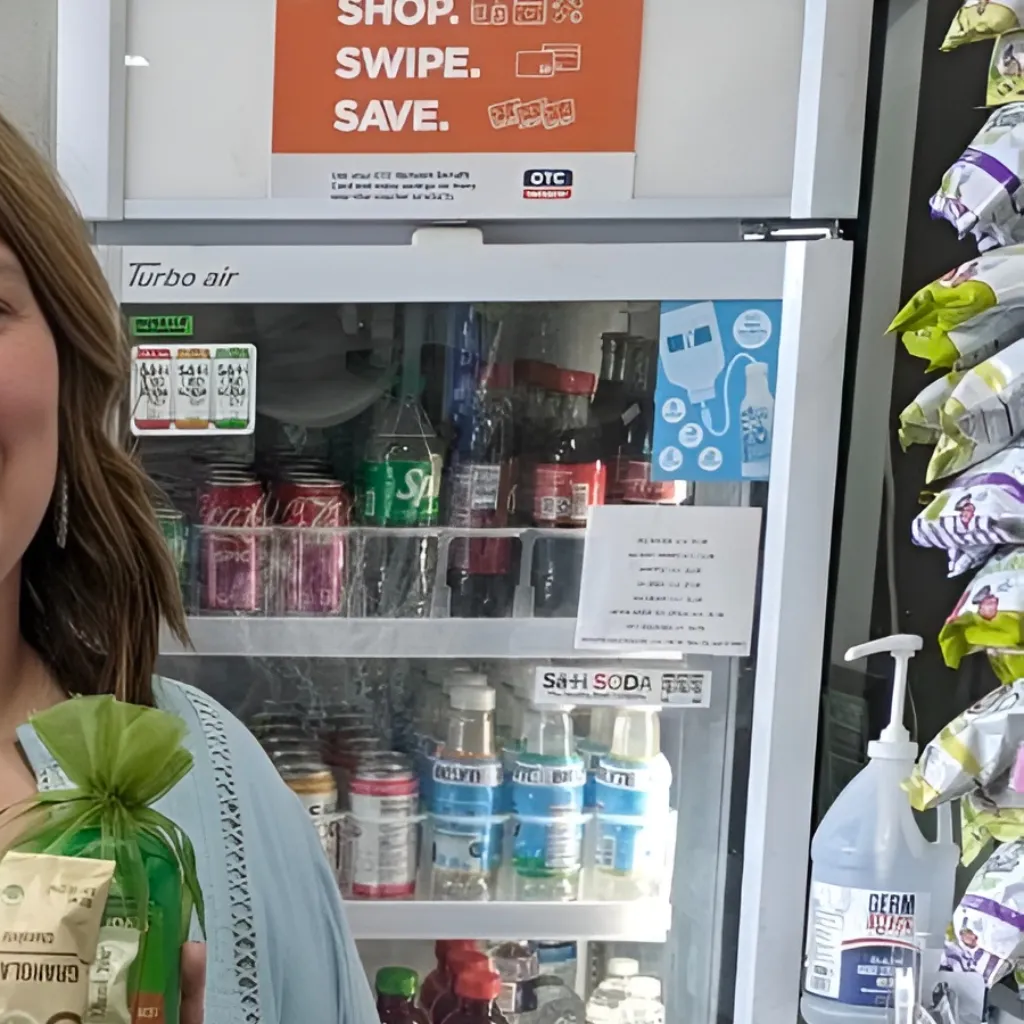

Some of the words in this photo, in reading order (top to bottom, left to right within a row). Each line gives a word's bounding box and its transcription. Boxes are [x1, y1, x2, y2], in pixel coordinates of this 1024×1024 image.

[337, 0, 459, 25] SHOP.
[335, 47, 480, 79] SWIPE.
[333, 99, 449, 131] SAVE.
[529, 172, 565, 185] OTC
[128, 262, 196, 287] Turbo
[203, 266, 239, 287] air
[592, 672, 652, 692] SODA
[868, 893, 915, 915] GERM
[0, 962, 80, 984] GRANOLA
